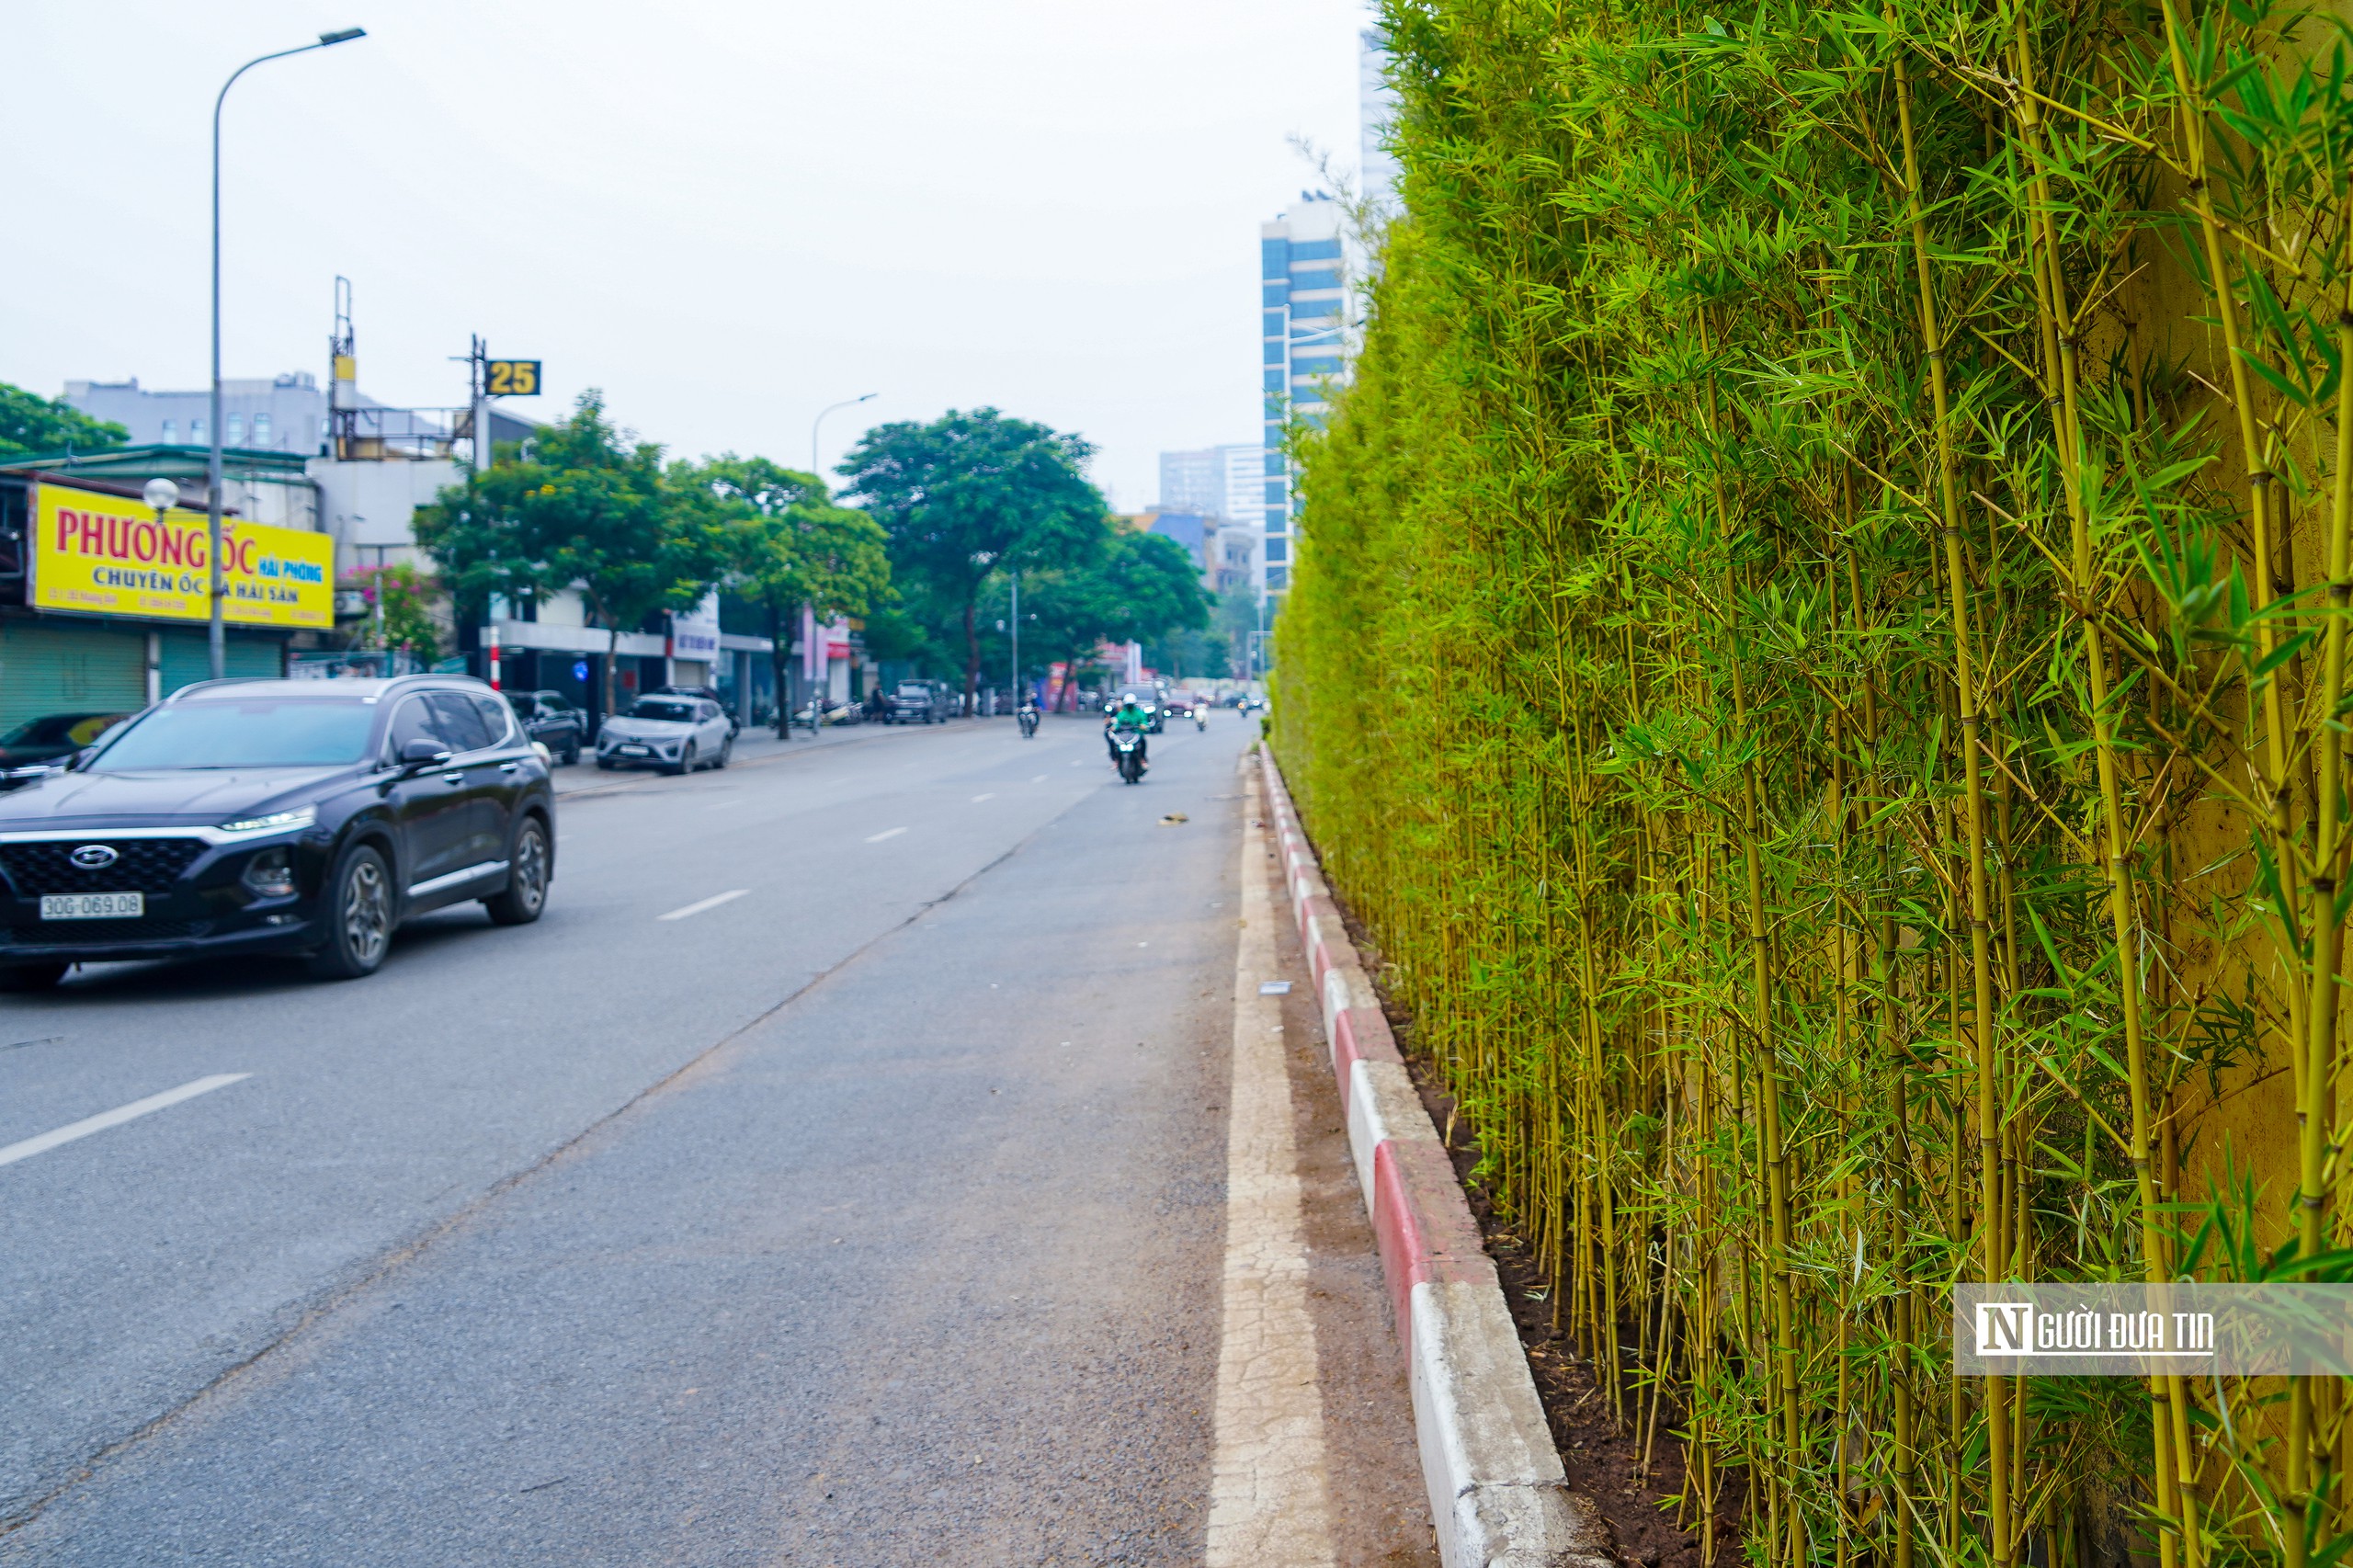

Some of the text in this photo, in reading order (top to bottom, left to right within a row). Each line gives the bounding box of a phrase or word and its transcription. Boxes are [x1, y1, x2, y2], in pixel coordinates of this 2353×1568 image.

[489, 361, 535, 393] 25
[93, 567, 173, 590] CHUYÊN
[178, 571, 204, 594] ỐC
